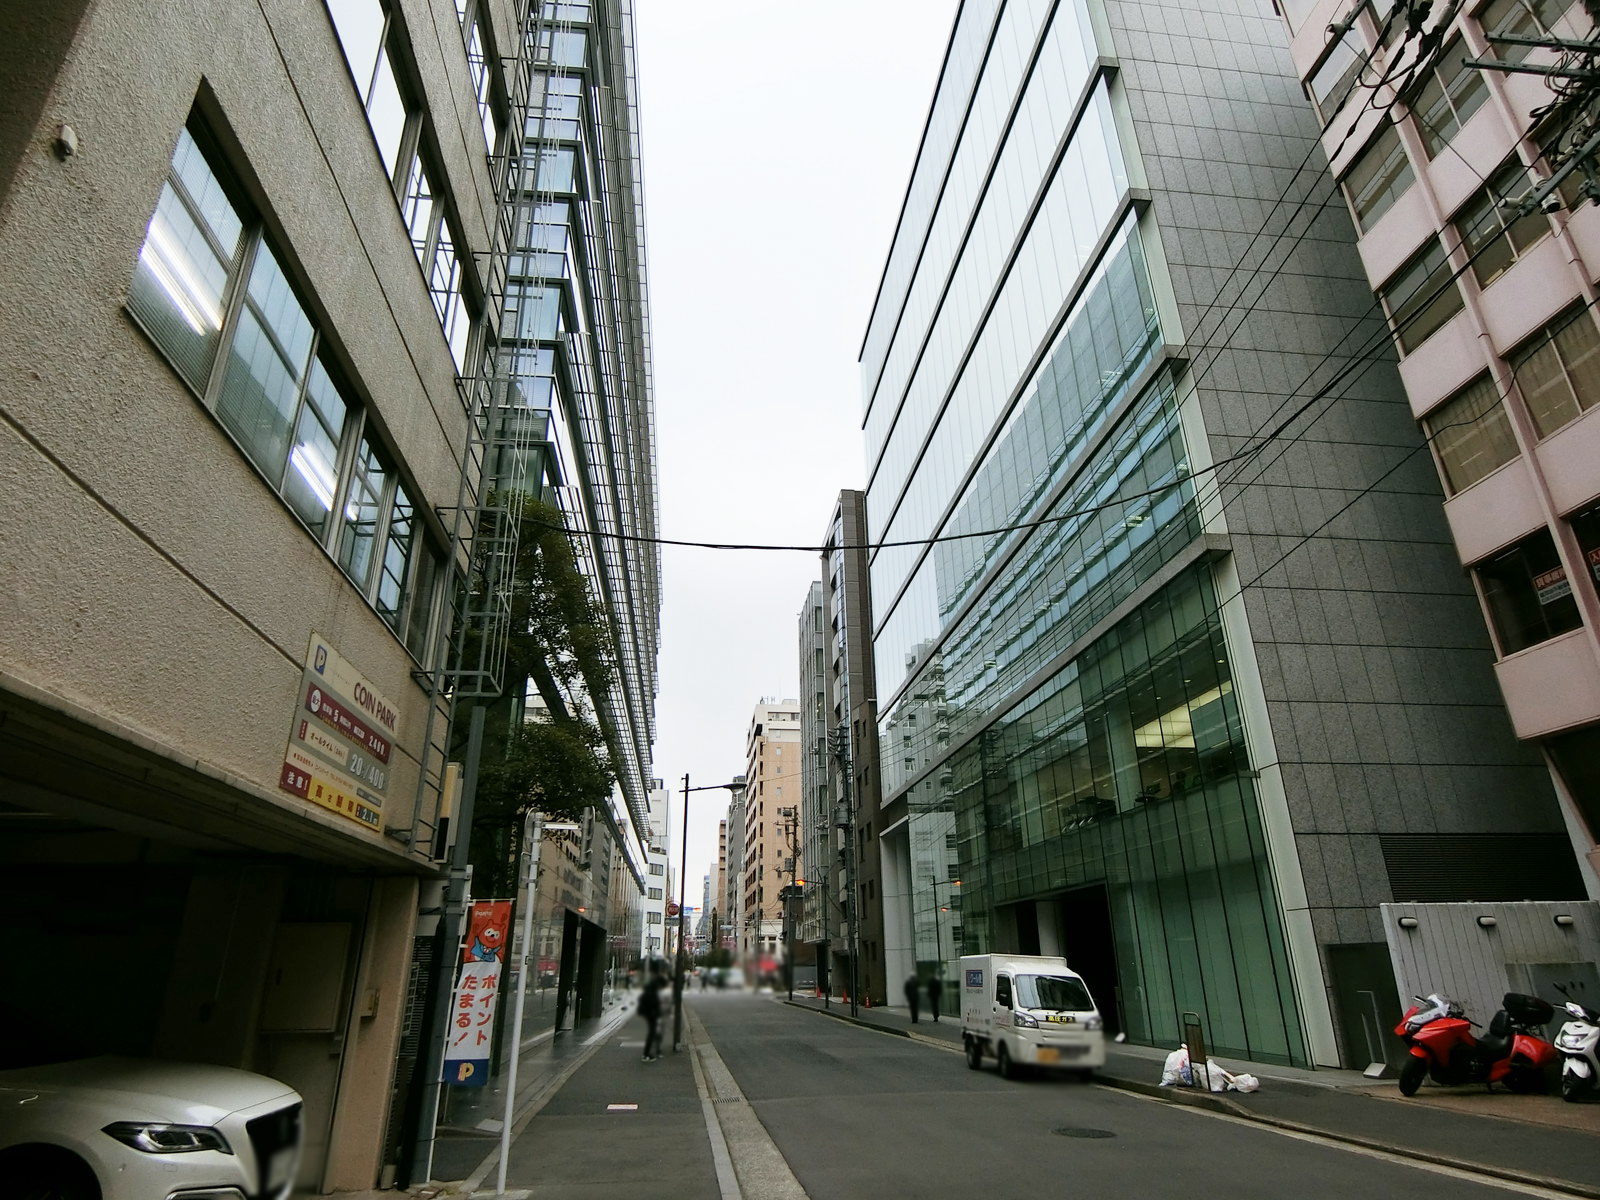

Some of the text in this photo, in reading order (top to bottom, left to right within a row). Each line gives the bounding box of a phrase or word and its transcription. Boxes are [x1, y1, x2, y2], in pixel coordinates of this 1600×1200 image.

[353, 682, 377, 715] COIN
[375, 702, 396, 731] PARK
[454, 974, 478, 1047] たまる!
[476, 974, 497, 1046] ポイント
